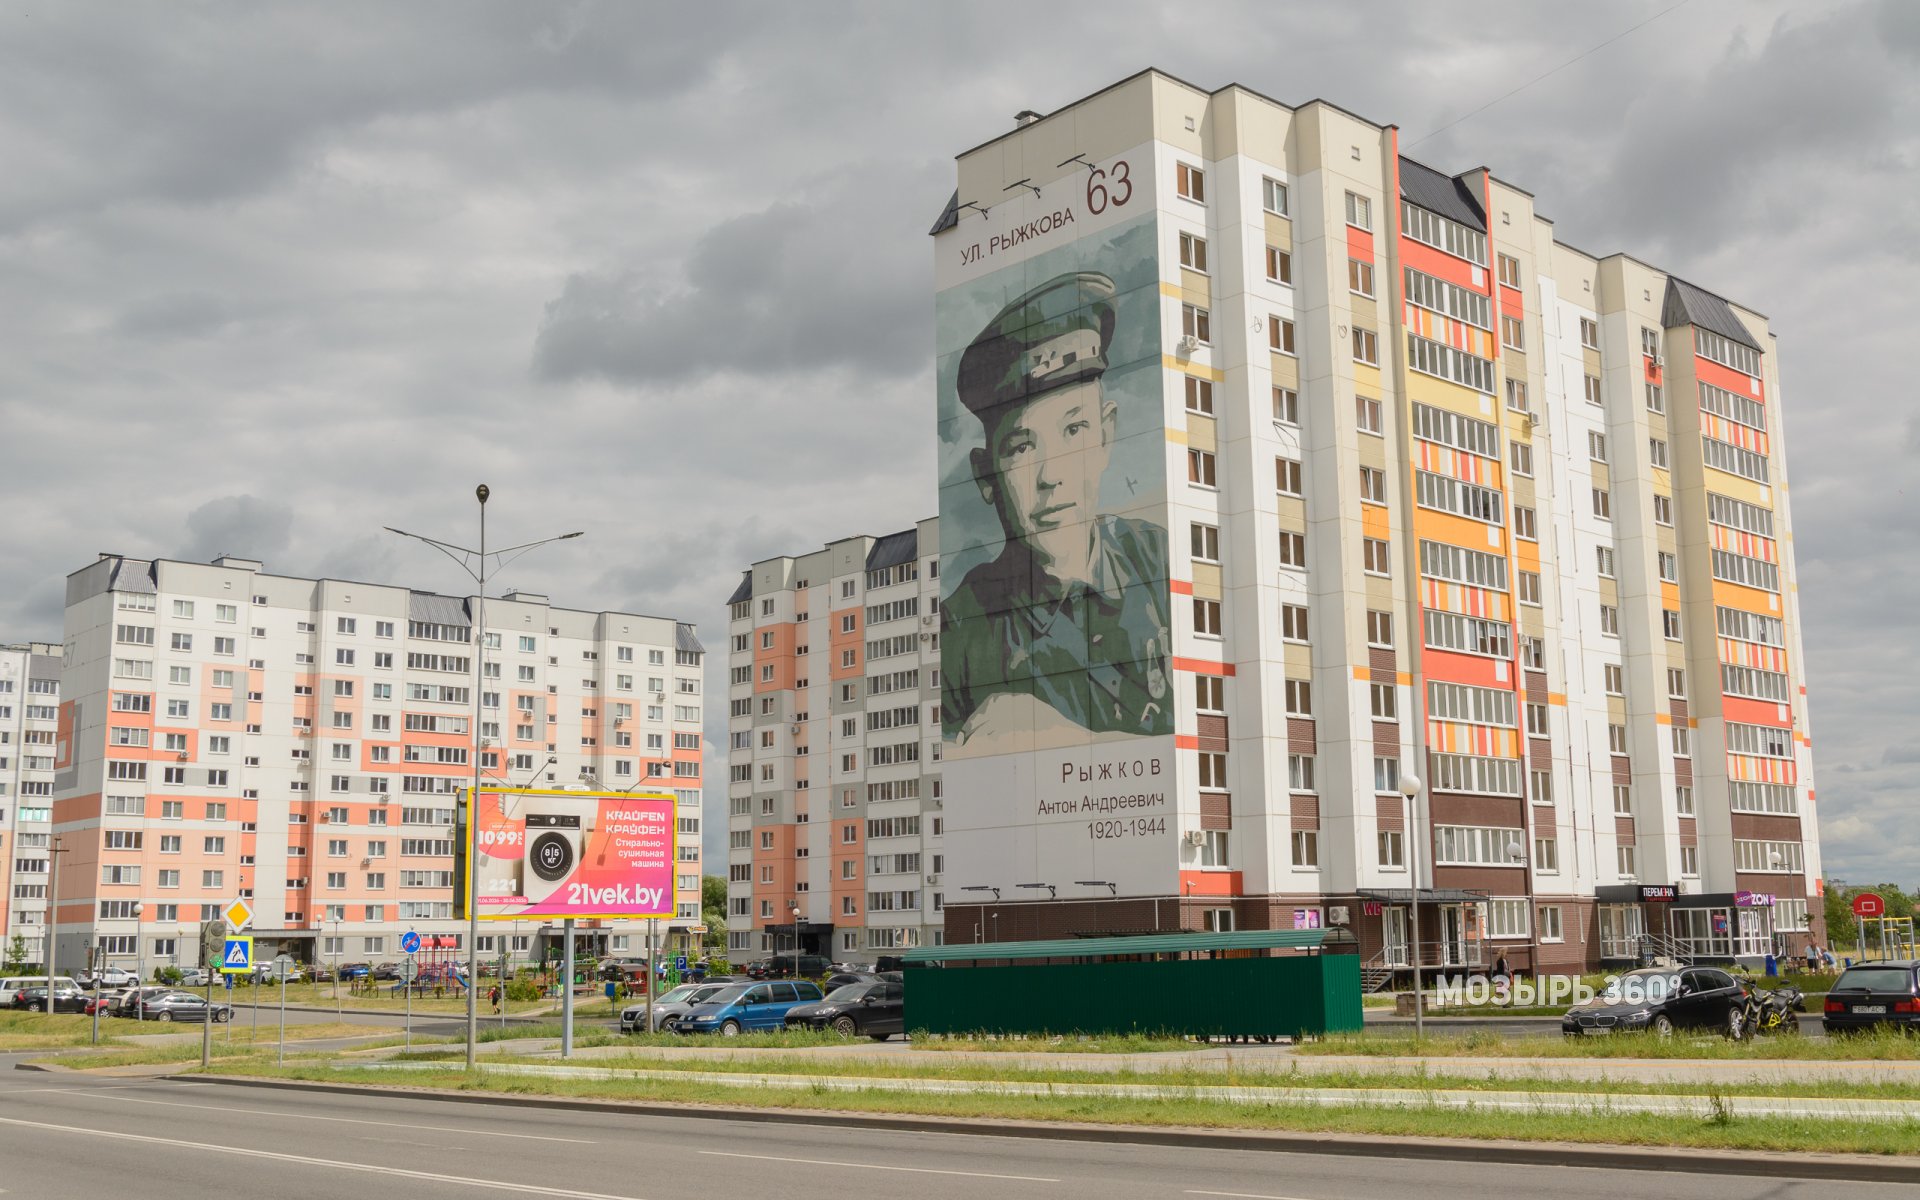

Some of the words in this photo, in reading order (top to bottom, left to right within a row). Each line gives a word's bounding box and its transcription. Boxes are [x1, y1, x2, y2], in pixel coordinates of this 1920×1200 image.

[960, 243, 985, 266] УЛ.
[990, 207, 1074, 255] РЫЖКОВА
[1086, 160, 1133, 215] 63
[1038, 799, 1077, 816] Антон
[1081, 792, 1164, 814] Андреевич
[1087, 817, 1167, 839] 1920-1944
[479, 830, 517, 845] 1099
[615, 838, 664, 848] Стирально-
[618, 850, 664, 859] сушильная
[631, 860, 664, 868] машина
[488, 878, 517, 892] 221
[567, 883, 664, 909] 21vek.by
[1751, 894, 1769, 905] ZON
[678, 958, 684, 968] P
